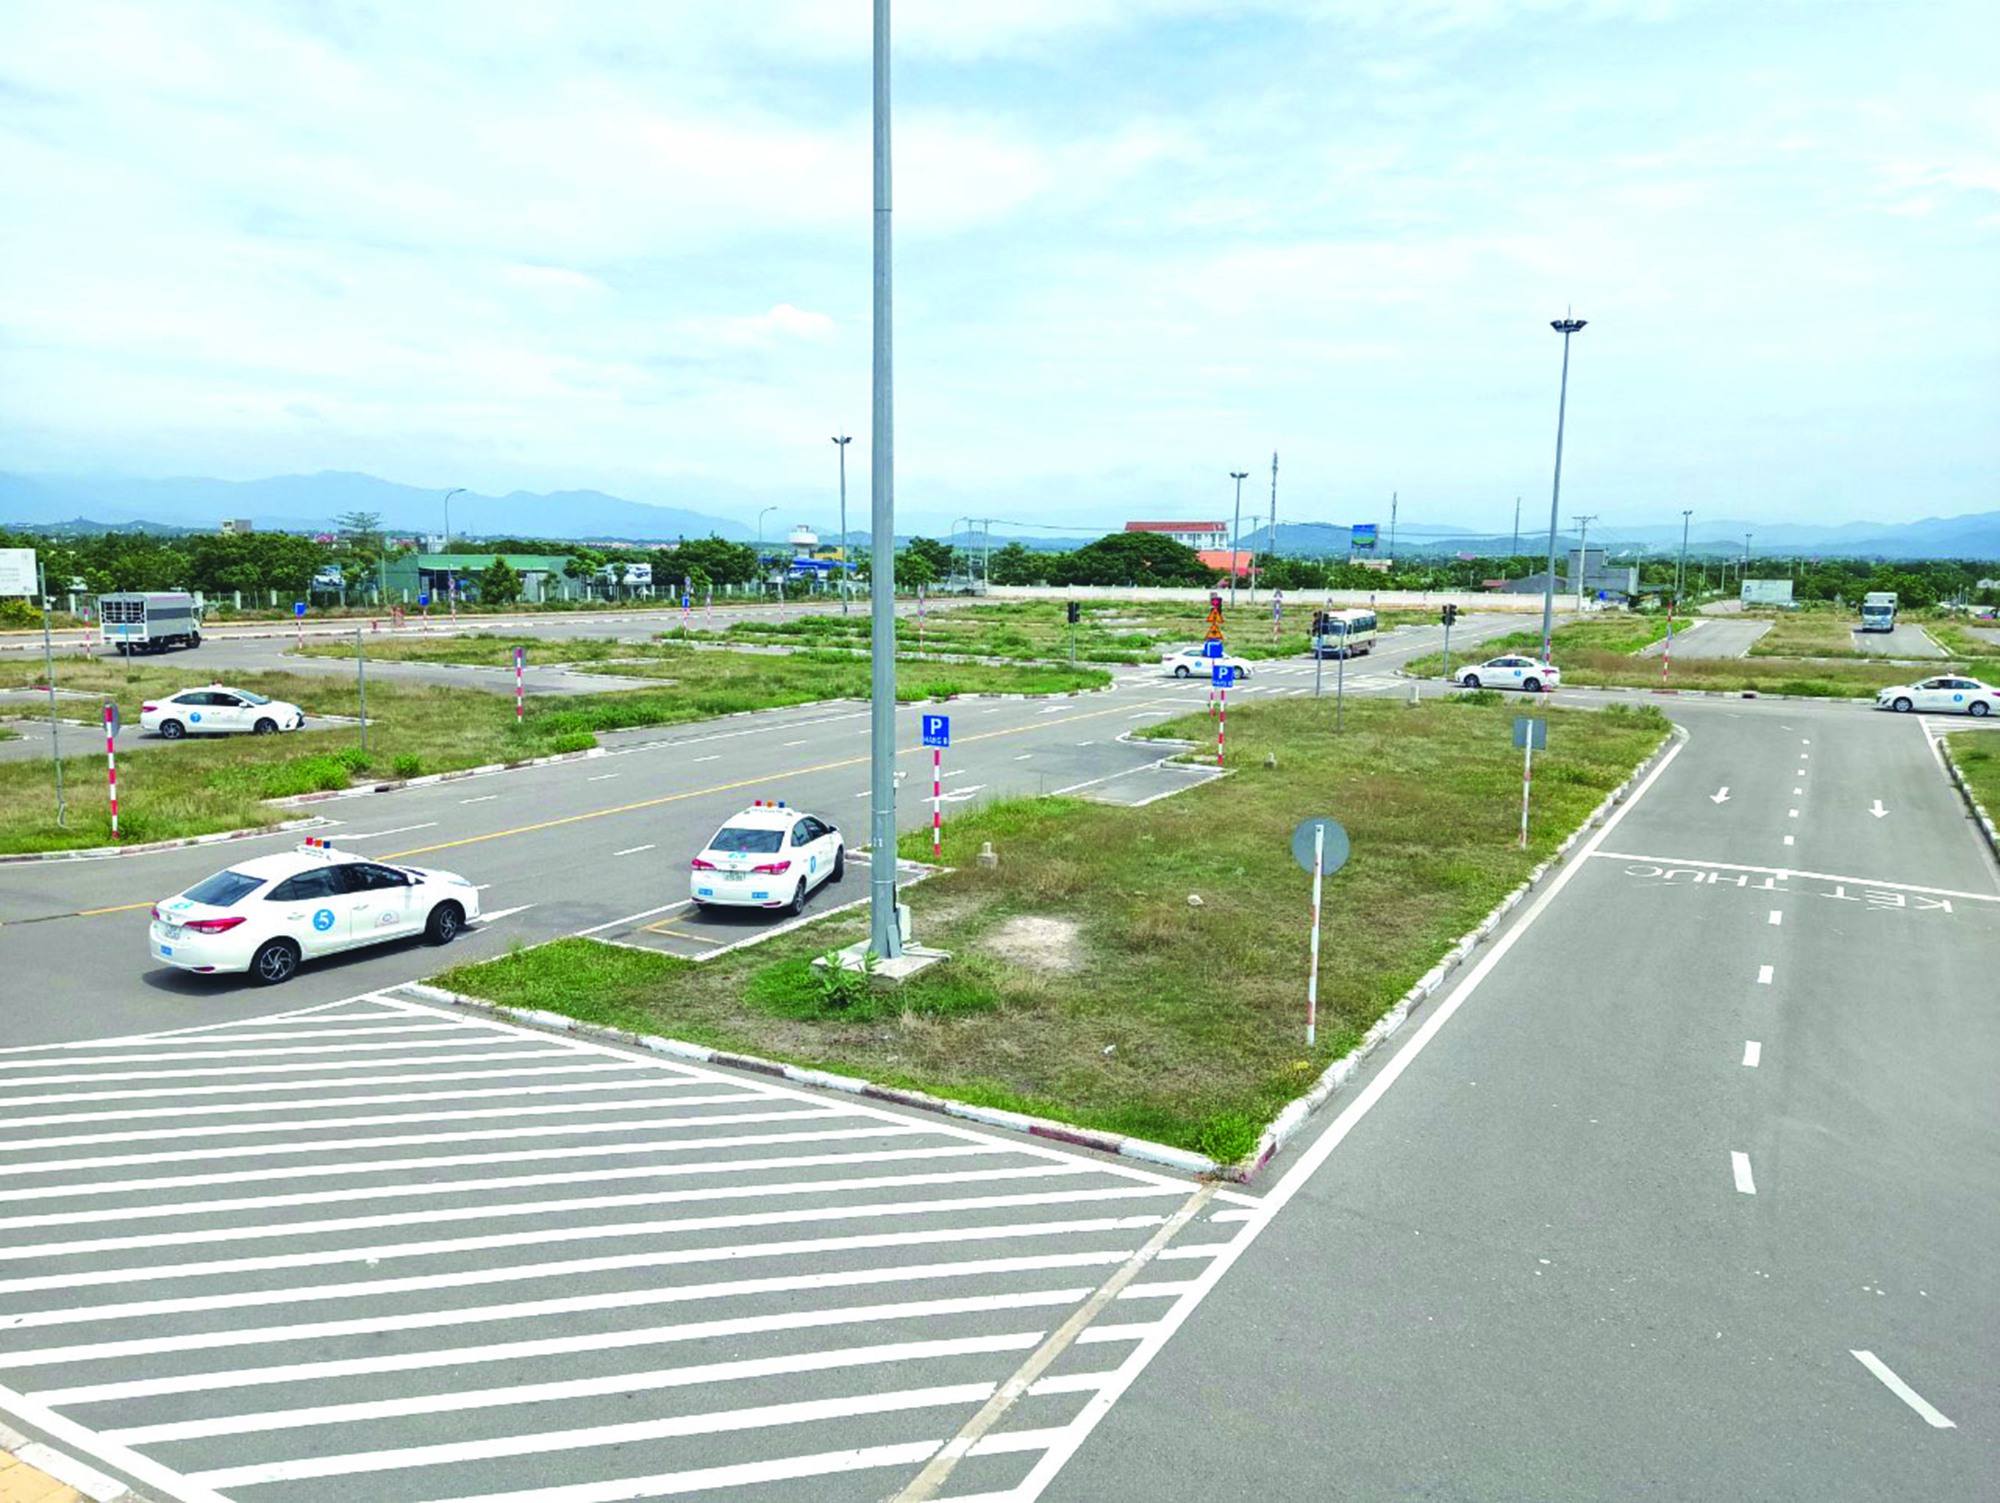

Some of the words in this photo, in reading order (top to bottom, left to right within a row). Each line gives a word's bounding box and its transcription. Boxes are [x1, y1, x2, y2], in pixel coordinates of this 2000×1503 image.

[1219, 666, 1228, 679] P
[930, 718, 942, 735] P
[318, 911, 330, 930] 5
